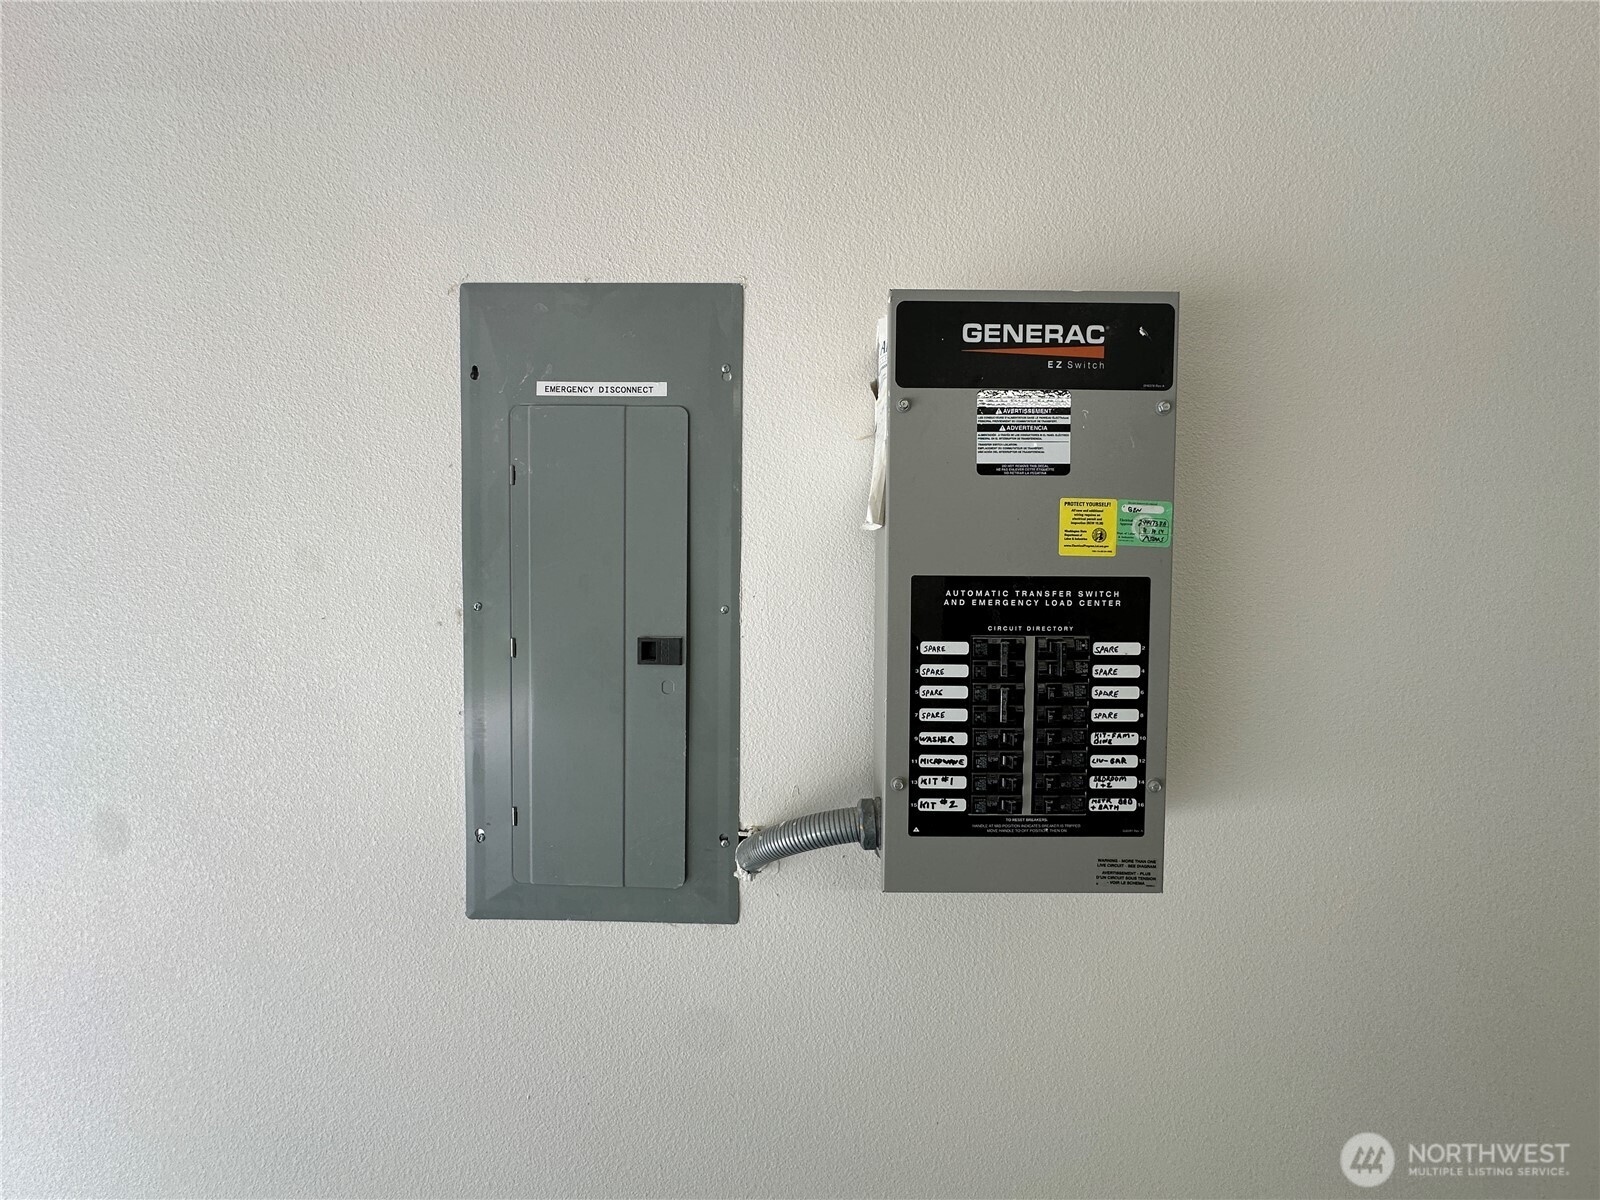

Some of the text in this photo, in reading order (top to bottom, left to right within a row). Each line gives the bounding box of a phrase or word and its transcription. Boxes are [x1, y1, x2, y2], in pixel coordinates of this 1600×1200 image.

[962, 323, 1105, 344] GENERAC
[1067, 361, 1105, 370] Switch
[544, 385, 654, 394] EMERGENCY DISCONNECT
[1094, 668, 1118, 676] SPARE
[1094, 689, 1119, 697] SPARE
[920, 801, 936, 809] KIT
